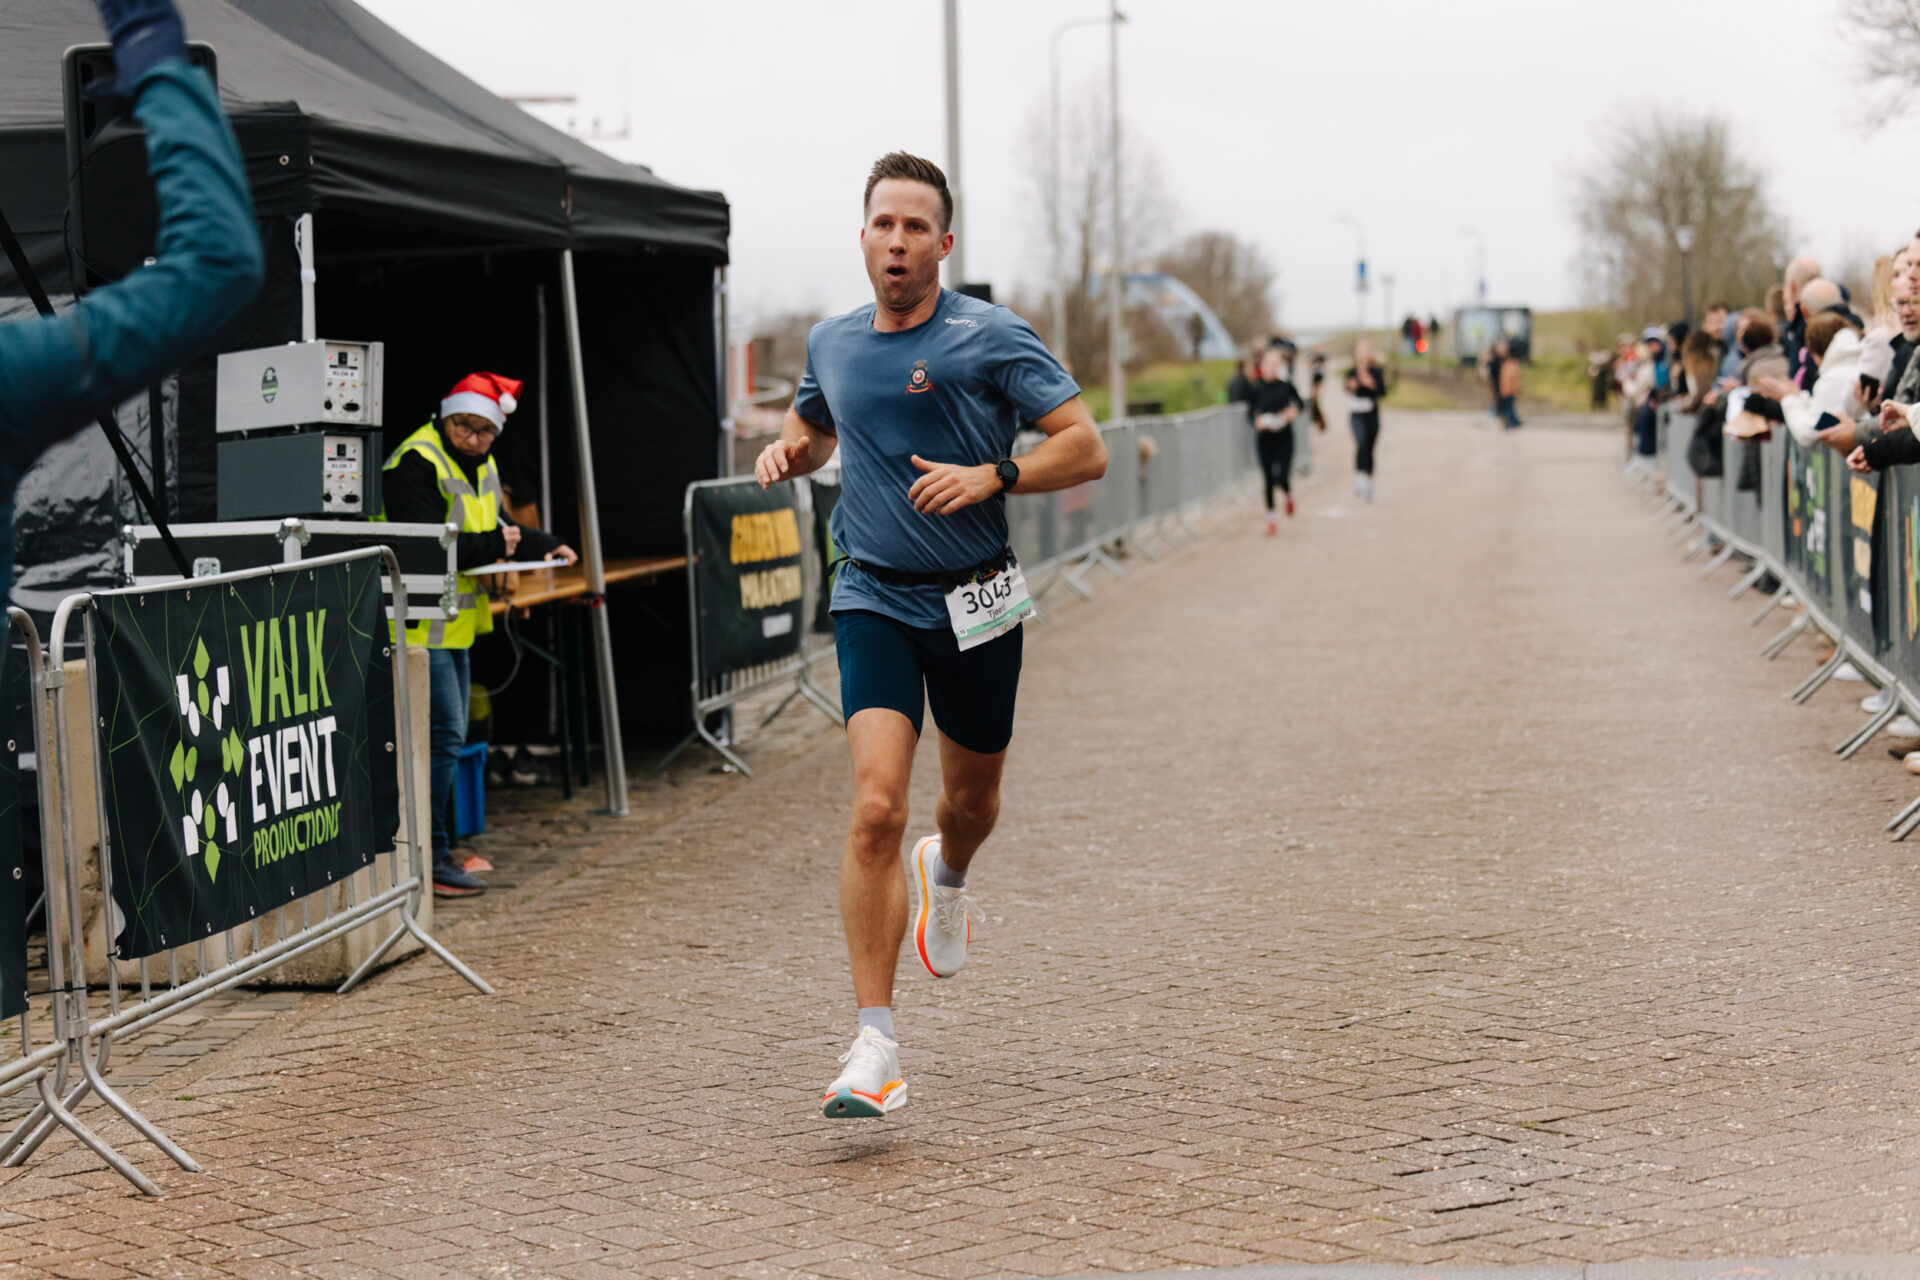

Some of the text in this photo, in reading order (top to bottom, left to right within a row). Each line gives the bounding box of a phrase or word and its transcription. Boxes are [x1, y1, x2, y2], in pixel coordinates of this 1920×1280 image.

[962, 576, 1011, 614] 3043
[240, 608, 332, 727] VALK
[248, 715, 336, 823] EVENT
[253, 801, 341, 869] PRODUCTIONS
